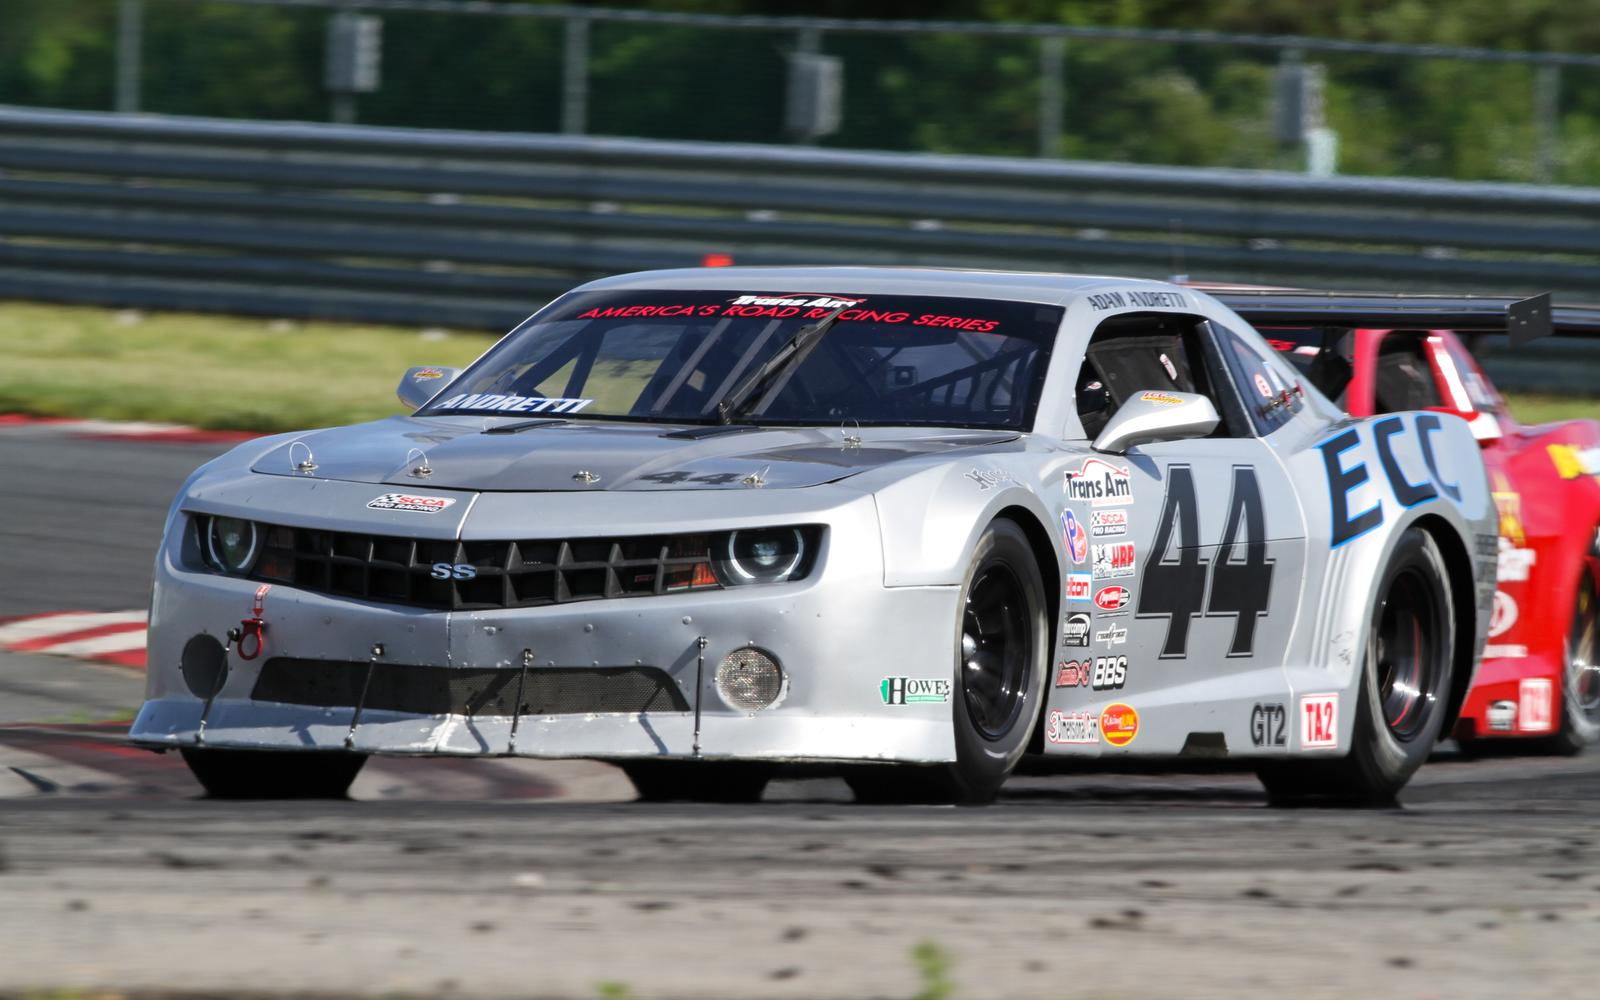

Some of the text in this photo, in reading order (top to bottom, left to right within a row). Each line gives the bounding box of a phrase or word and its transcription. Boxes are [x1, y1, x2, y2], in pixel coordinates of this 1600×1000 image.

[731, 295, 858, 308] Trans Am
[1087, 291, 1188, 311] ADAM ANDRETTI
[577, 304, 716, 320] AMERICA'S
[720, 305, 800, 318] ROAD
[913, 314, 1000, 333] SERIES
[432, 394, 593, 414] ANDRETTI
[635, 471, 742, 485] 44
[1065, 471, 1131, 499] Trans Am
[1314, 413, 1463, 550] ECC
[370, 501, 440, 513] PRO RACING
[399, 496, 446, 508] SCCA
[1100, 513, 1126, 525] SCCA
[1092, 525, 1126, 534] PRO RACING
[430, 562, 478, 580] SS
[1135, 463, 1276, 660] 44
[1093, 655, 1128, 690] BBS
[1251, 703, 1287, 747] GT2
[1305, 701, 1334, 742] TA2
